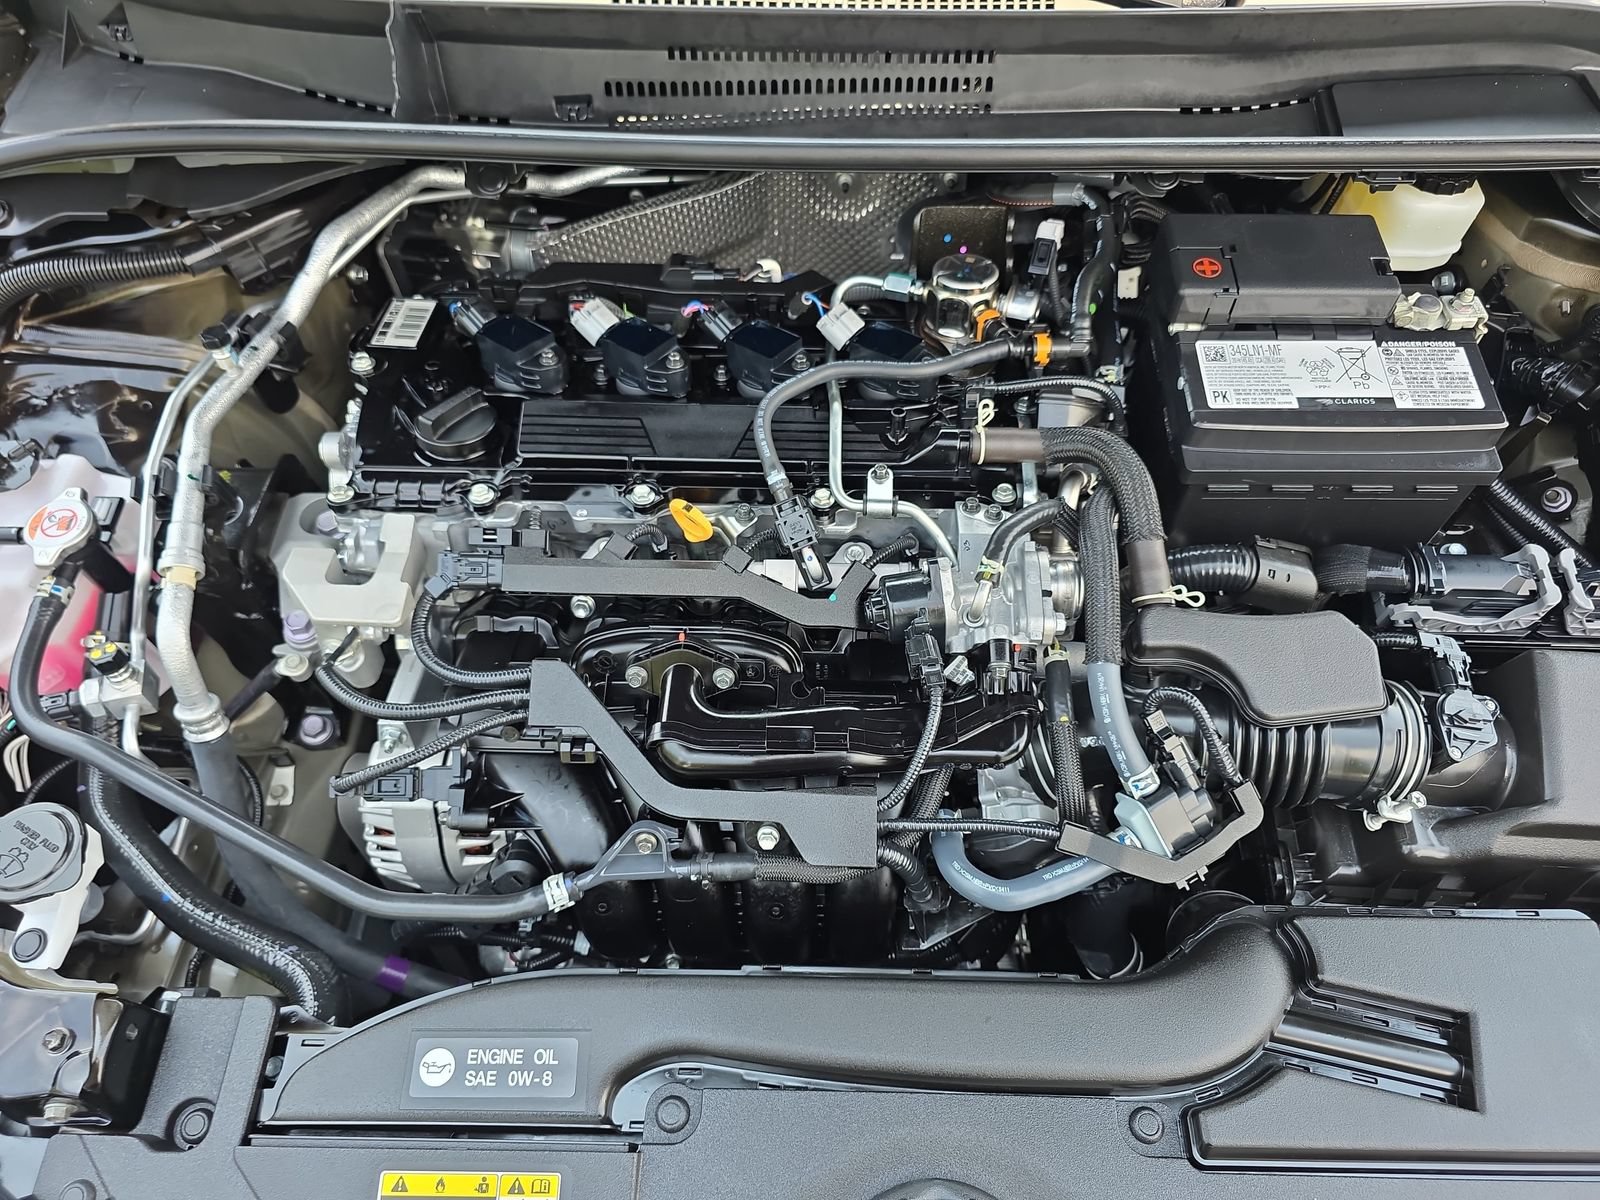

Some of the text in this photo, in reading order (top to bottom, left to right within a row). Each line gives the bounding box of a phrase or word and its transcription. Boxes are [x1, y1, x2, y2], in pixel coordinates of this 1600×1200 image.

[1229, 344, 1283, 357] 345LN1-MF
[1353, 381, 1370, 390] Pb
[1212, 390, 1230, 403] PK
[466, 1048, 559, 1065] ENGINE OIL
[464, 1070, 553, 1087] SAE 0W-8
